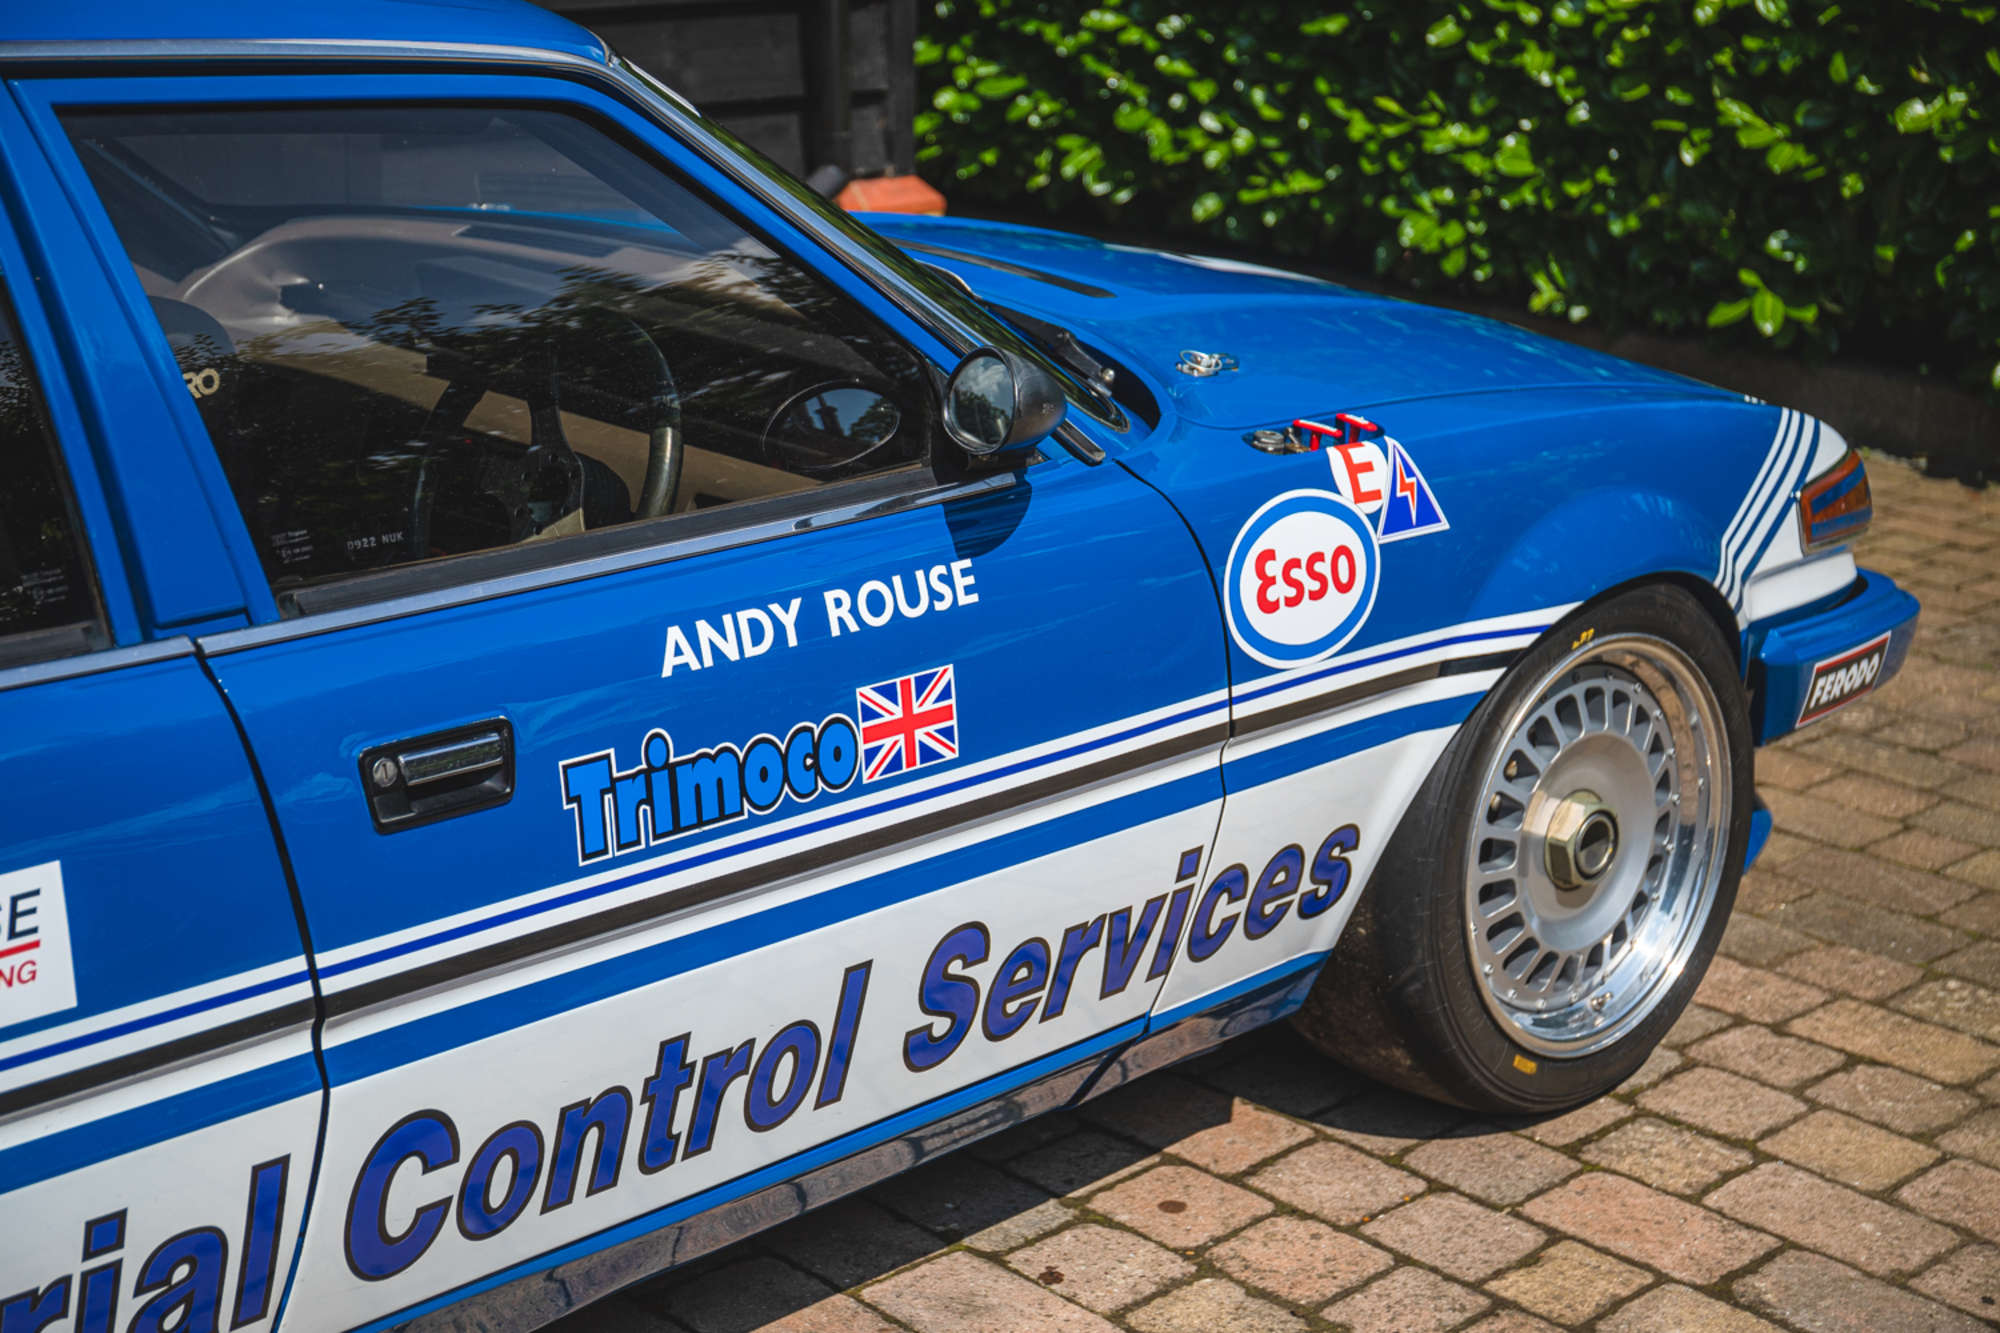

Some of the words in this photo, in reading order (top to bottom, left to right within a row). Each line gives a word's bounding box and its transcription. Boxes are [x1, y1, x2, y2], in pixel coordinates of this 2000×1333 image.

[1333, 443, 1383, 505] E
[661, 597, 802, 678] ANDY
[823, 558, 979, 638] ROUSE
[1810, 653, 1881, 708] FERODO
[559, 712, 860, 866] Trimoco
[0, 888, 41, 941] E
[344, 959, 874, 1282] Control
[902, 823, 1361, 1074] Services
